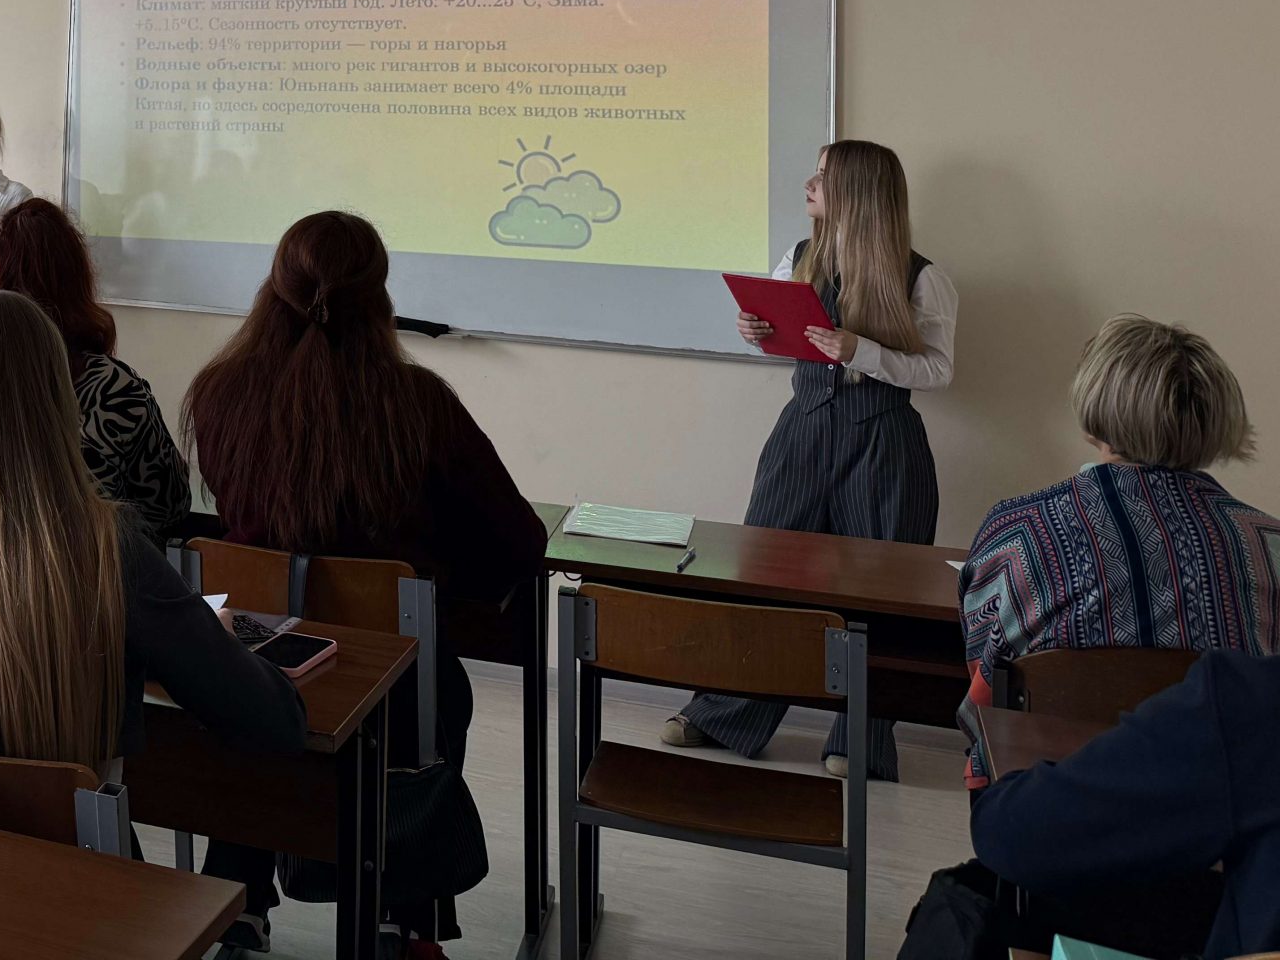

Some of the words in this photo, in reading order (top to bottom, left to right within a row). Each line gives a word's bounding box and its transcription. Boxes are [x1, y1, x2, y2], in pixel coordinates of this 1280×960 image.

[208, 17, 299, 31] Сезонность
[304, 18, 407, 32] отсутствует.
[135, 38, 203, 52] Рельеф:
[208, 38, 241, 51] 94%
[247, 39, 341, 53] территории
[370, 39, 411, 52] горы
[417, 40, 428, 50] и
[434, 40, 507, 54] нагорья
[135, 58, 202, 71] Водные
[292, 60, 341, 72] много
[346, 60, 376, 75] рек
[381, 60, 459, 73] гигантов
[466, 61, 477, 73] и
[483, 61, 617, 76] высокогорных
[624, 63, 667, 77] озер
[134, 77, 191, 92] Флора
[196, 79, 207, 90] и
[213, 77, 273, 94] фауна:
[279, 79, 359, 93] Юньнань
[363, 81, 448, 93] занимает
[453, 82, 500, 94] всего
[506, 81, 532, 95] 4%
[539, 84, 627, 97] площади
[215, 101, 258, 114] здесь
[262, 102, 380, 116] сосредоточена
[387, 103, 471, 117] половина
[479, 104, 517, 116] всех
[523, 106, 578, 118] видов
[585, 107, 686, 121] животных
[135, 119, 144, 130] и
[149, 118, 221, 133] растений
[226, 121, 285, 135] страны
